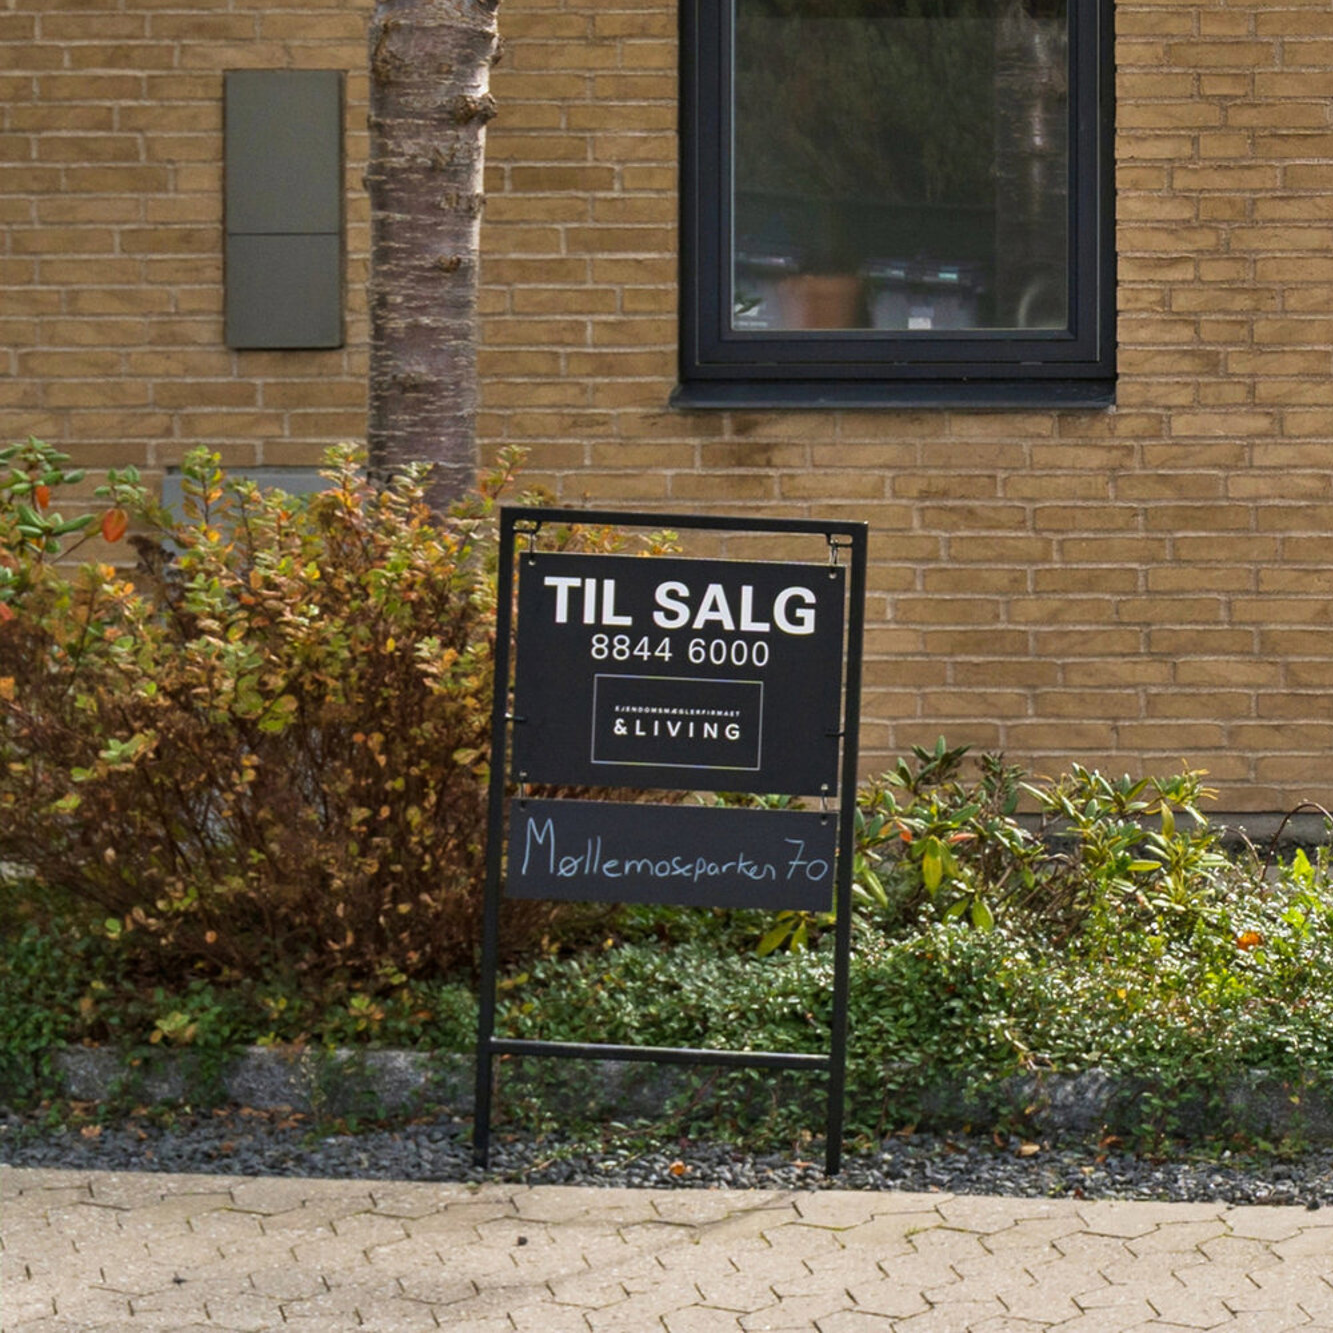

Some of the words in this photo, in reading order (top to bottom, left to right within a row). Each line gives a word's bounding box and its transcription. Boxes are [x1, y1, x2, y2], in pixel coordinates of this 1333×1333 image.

[543, 575, 633, 627] TIL
[652, 580, 817, 636] SALG
[590, 633, 673, 662] 8844
[688, 637, 770, 667] 6000
[613, 717, 740, 741] &LIVING
[784, 837, 829, 882] 70
